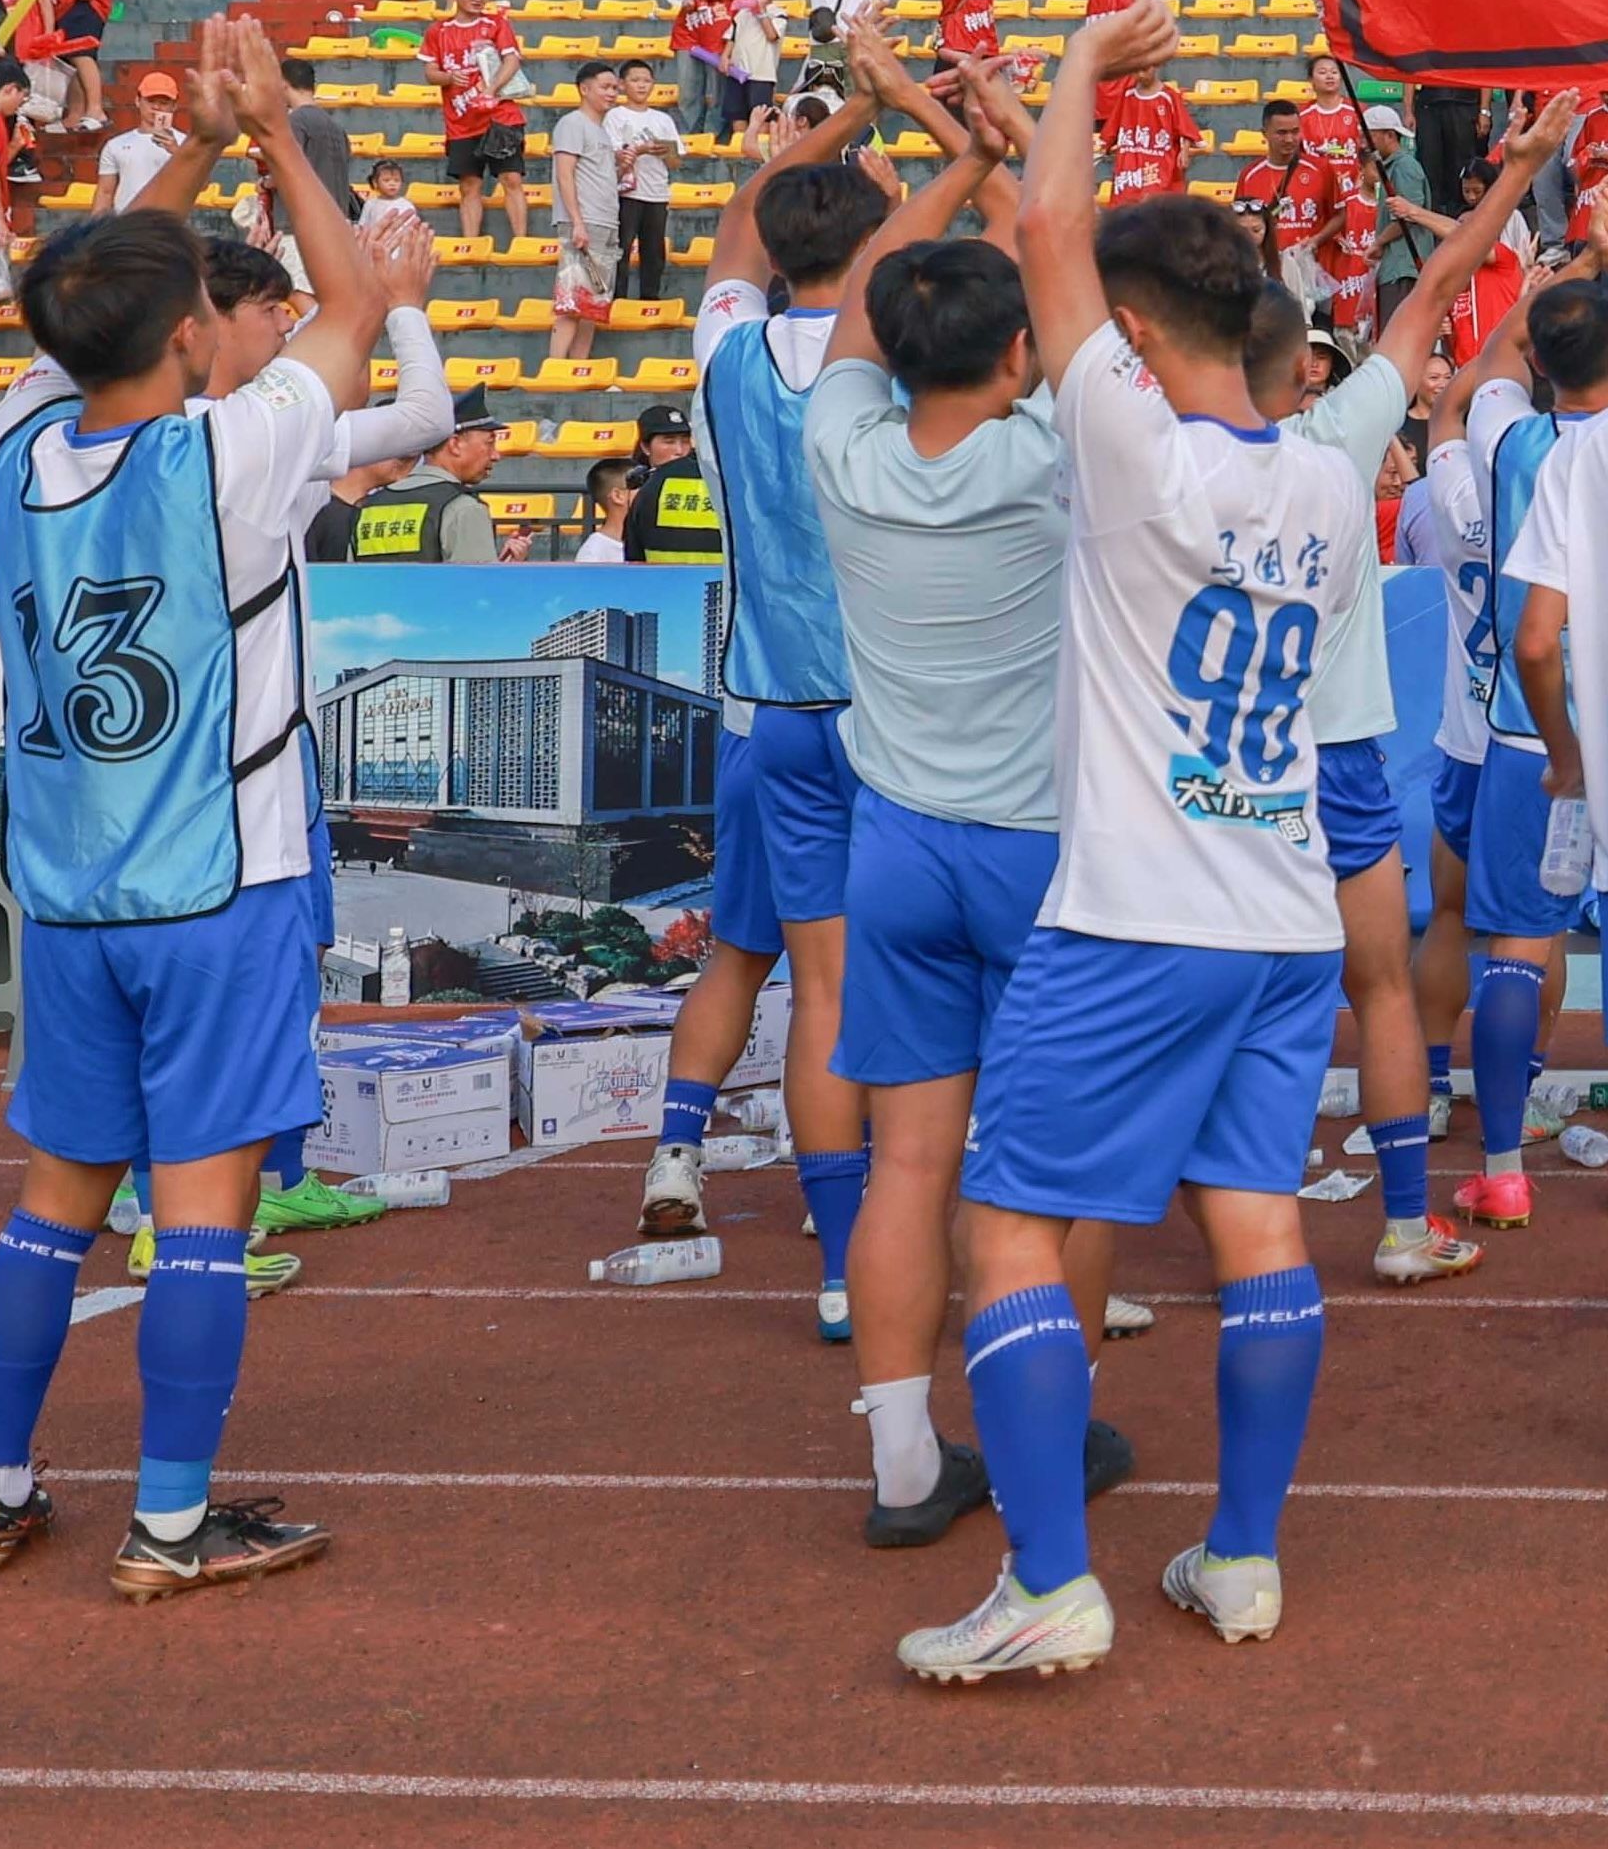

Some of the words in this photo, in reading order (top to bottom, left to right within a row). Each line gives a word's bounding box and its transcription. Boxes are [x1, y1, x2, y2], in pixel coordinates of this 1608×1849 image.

[12, 575, 179, 763] 13
[1165, 583, 1319, 784] 98
[149, 1257, 206, 1272] ELME
